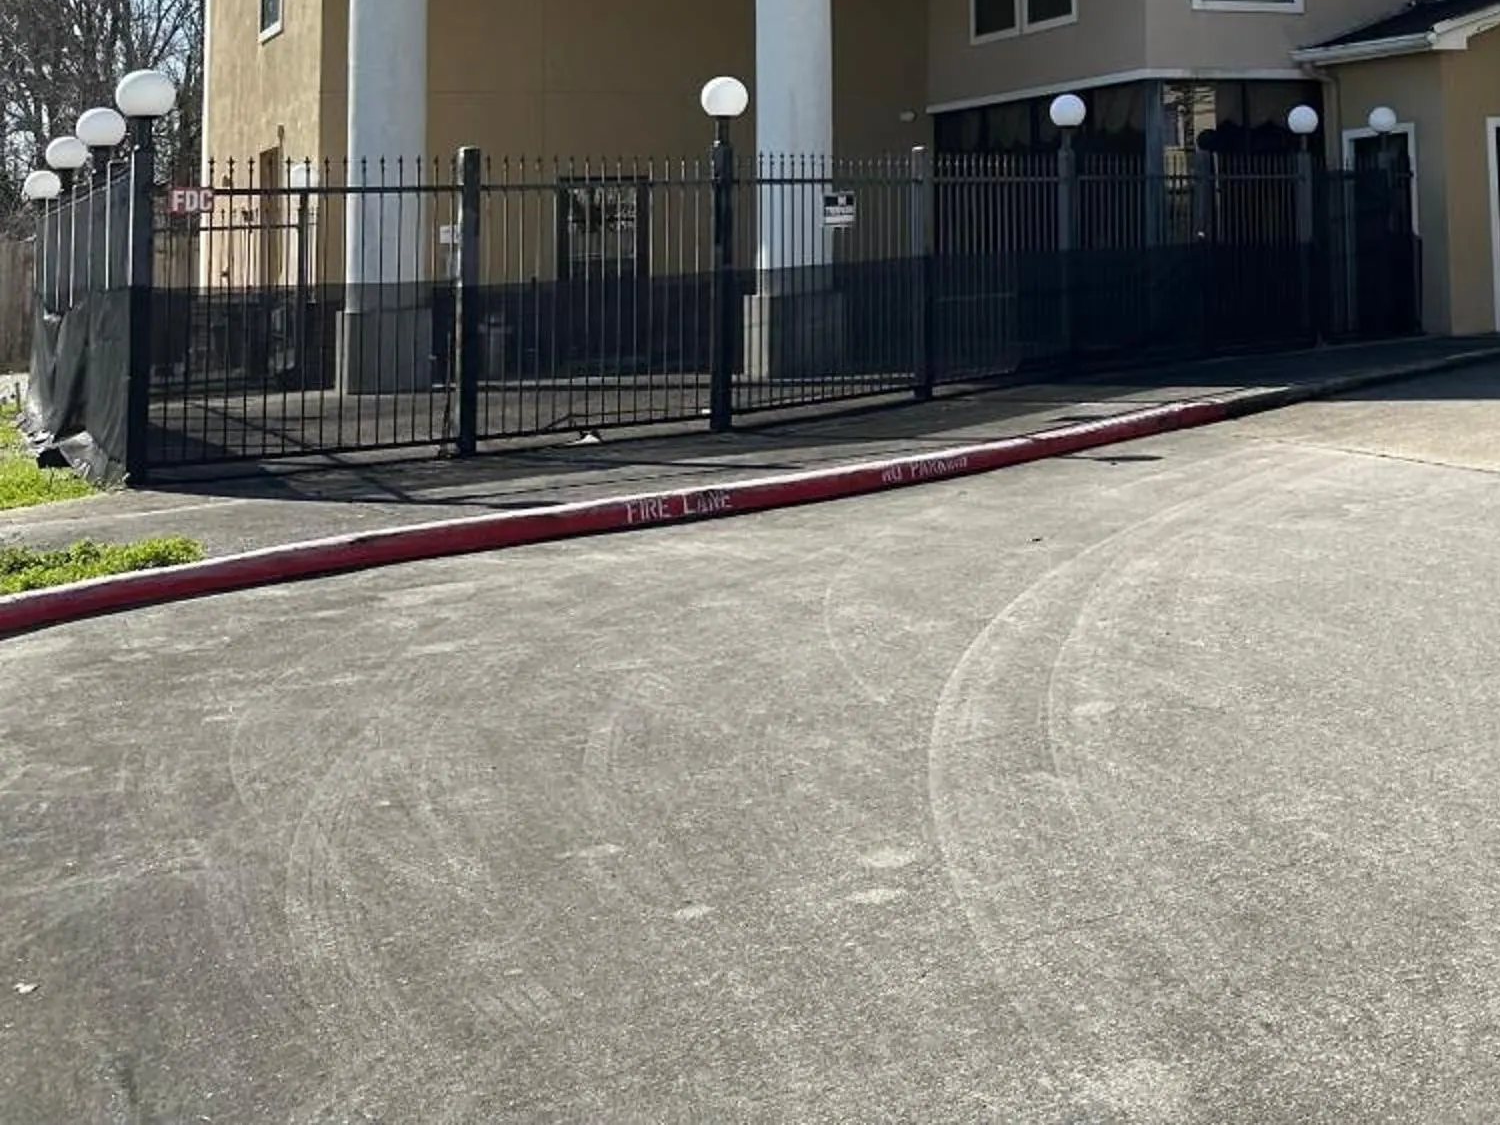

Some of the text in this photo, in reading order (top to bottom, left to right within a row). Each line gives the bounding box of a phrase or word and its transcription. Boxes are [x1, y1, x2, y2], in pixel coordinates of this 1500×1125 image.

[172, 189, 213, 212] FDC
[624, 489, 733, 524] FIRE LANE
